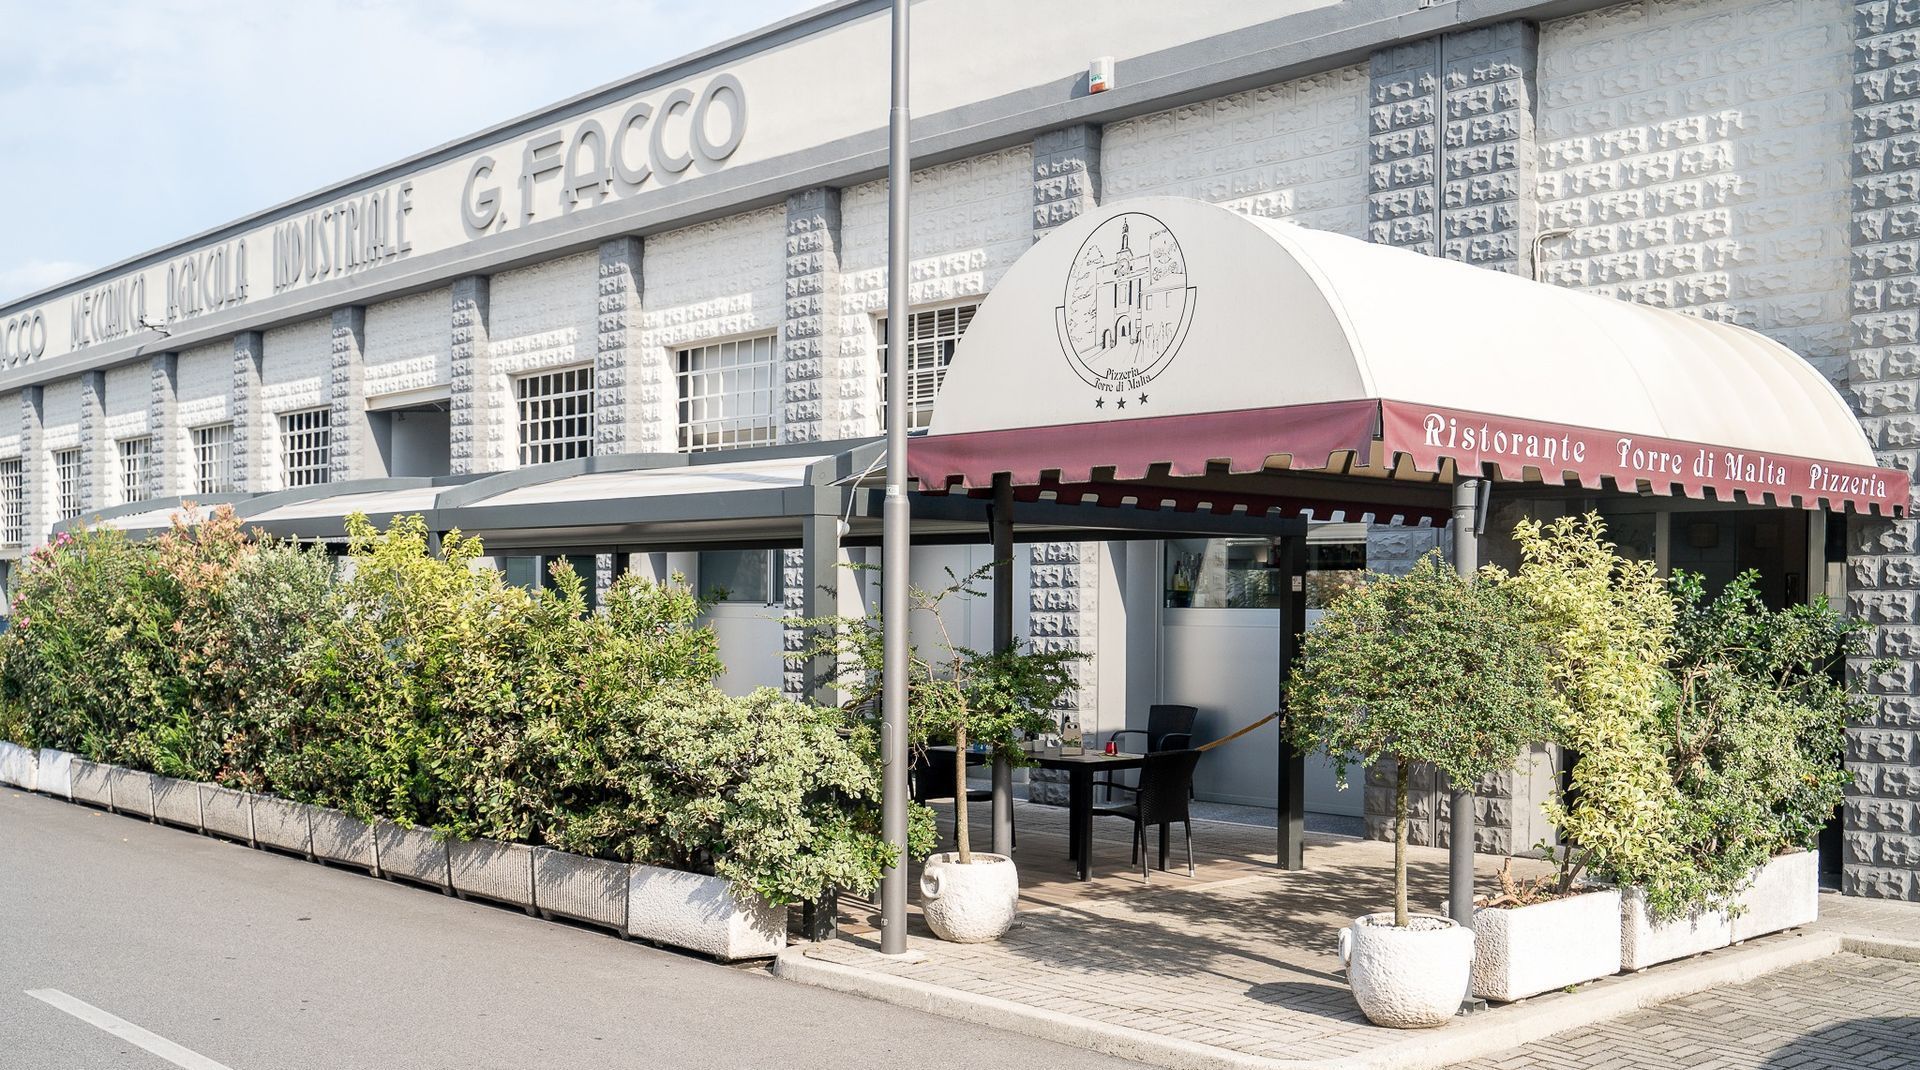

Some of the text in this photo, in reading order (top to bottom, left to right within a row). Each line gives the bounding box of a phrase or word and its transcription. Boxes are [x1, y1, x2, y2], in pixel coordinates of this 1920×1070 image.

[71, 273, 147, 350] MECCANICA
[167, 239, 248, 320] AGRICOLA
[273, 181, 413, 291] INDUSTRIALE
[519, 73, 746, 216] FACCO
[1095, 375, 1151, 392] Torre di Malta
[1105, 367, 1139, 380] Pizzeria
[1423, 413, 1887, 498] Ristorante Torre di Malta Pizzeria
